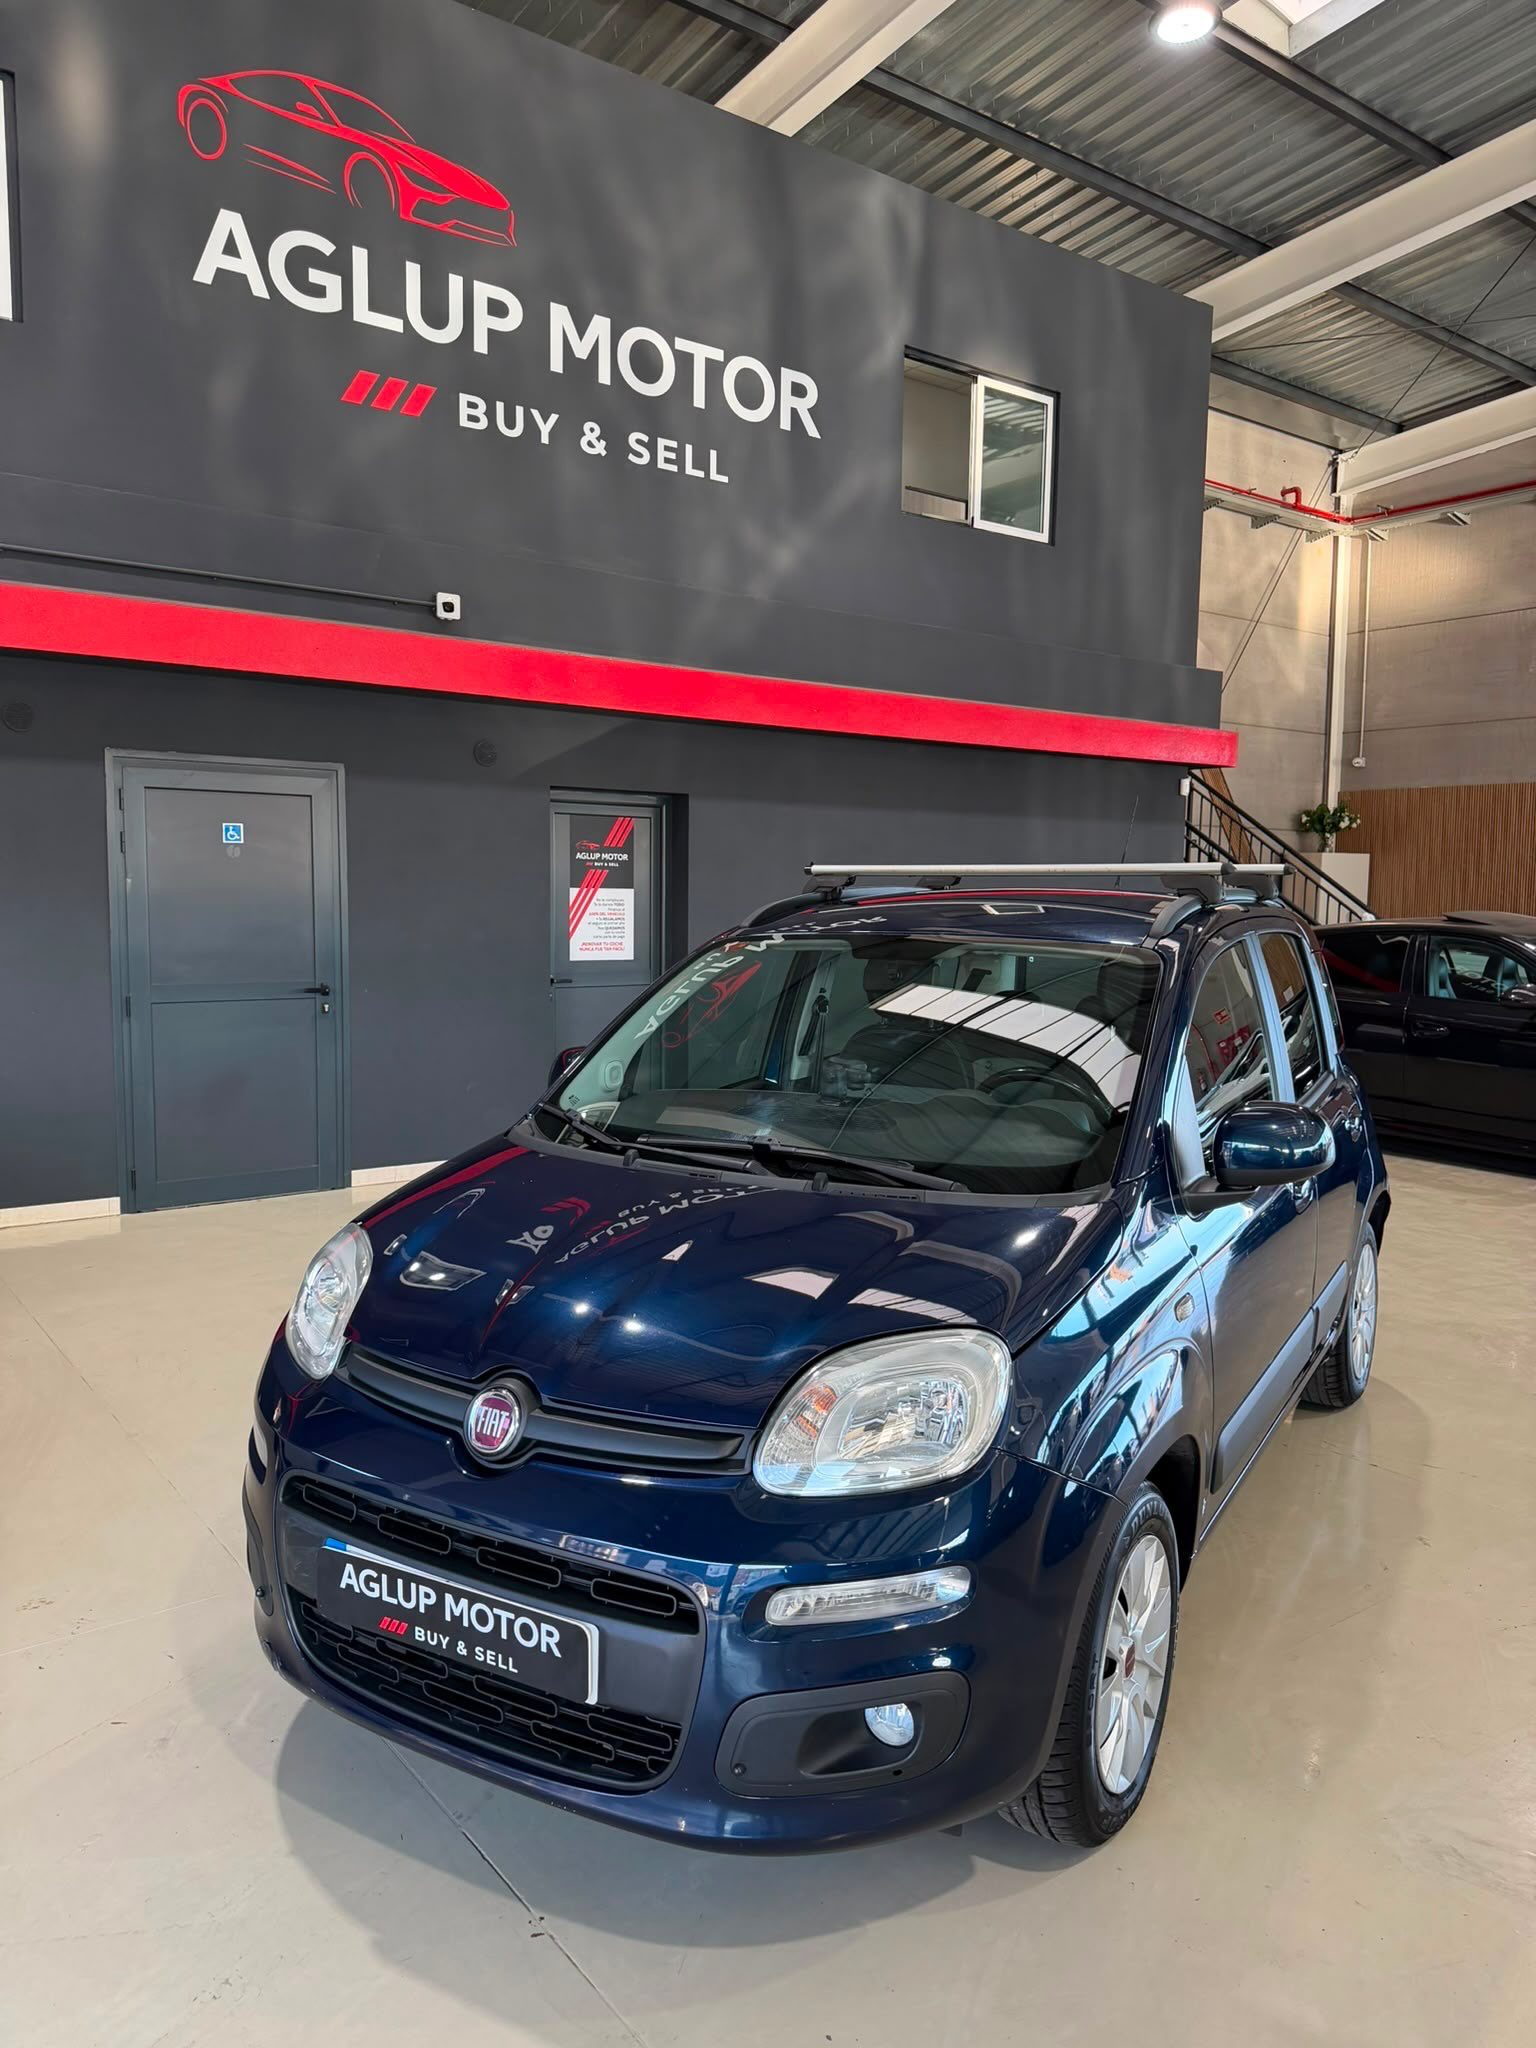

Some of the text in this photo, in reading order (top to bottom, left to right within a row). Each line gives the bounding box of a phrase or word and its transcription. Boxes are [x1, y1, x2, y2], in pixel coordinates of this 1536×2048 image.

[193, 208, 822, 440] AGLUP MOTOR
[458, 392, 729, 484] BUY & SELL
[575, 851, 629, 861] AGLUP MOTOR
[476, 1405, 510, 1438] FIAT
[339, 1562, 562, 1658] AGLUP MOTOR
[414, 1626, 519, 1674] BUY & SELL
